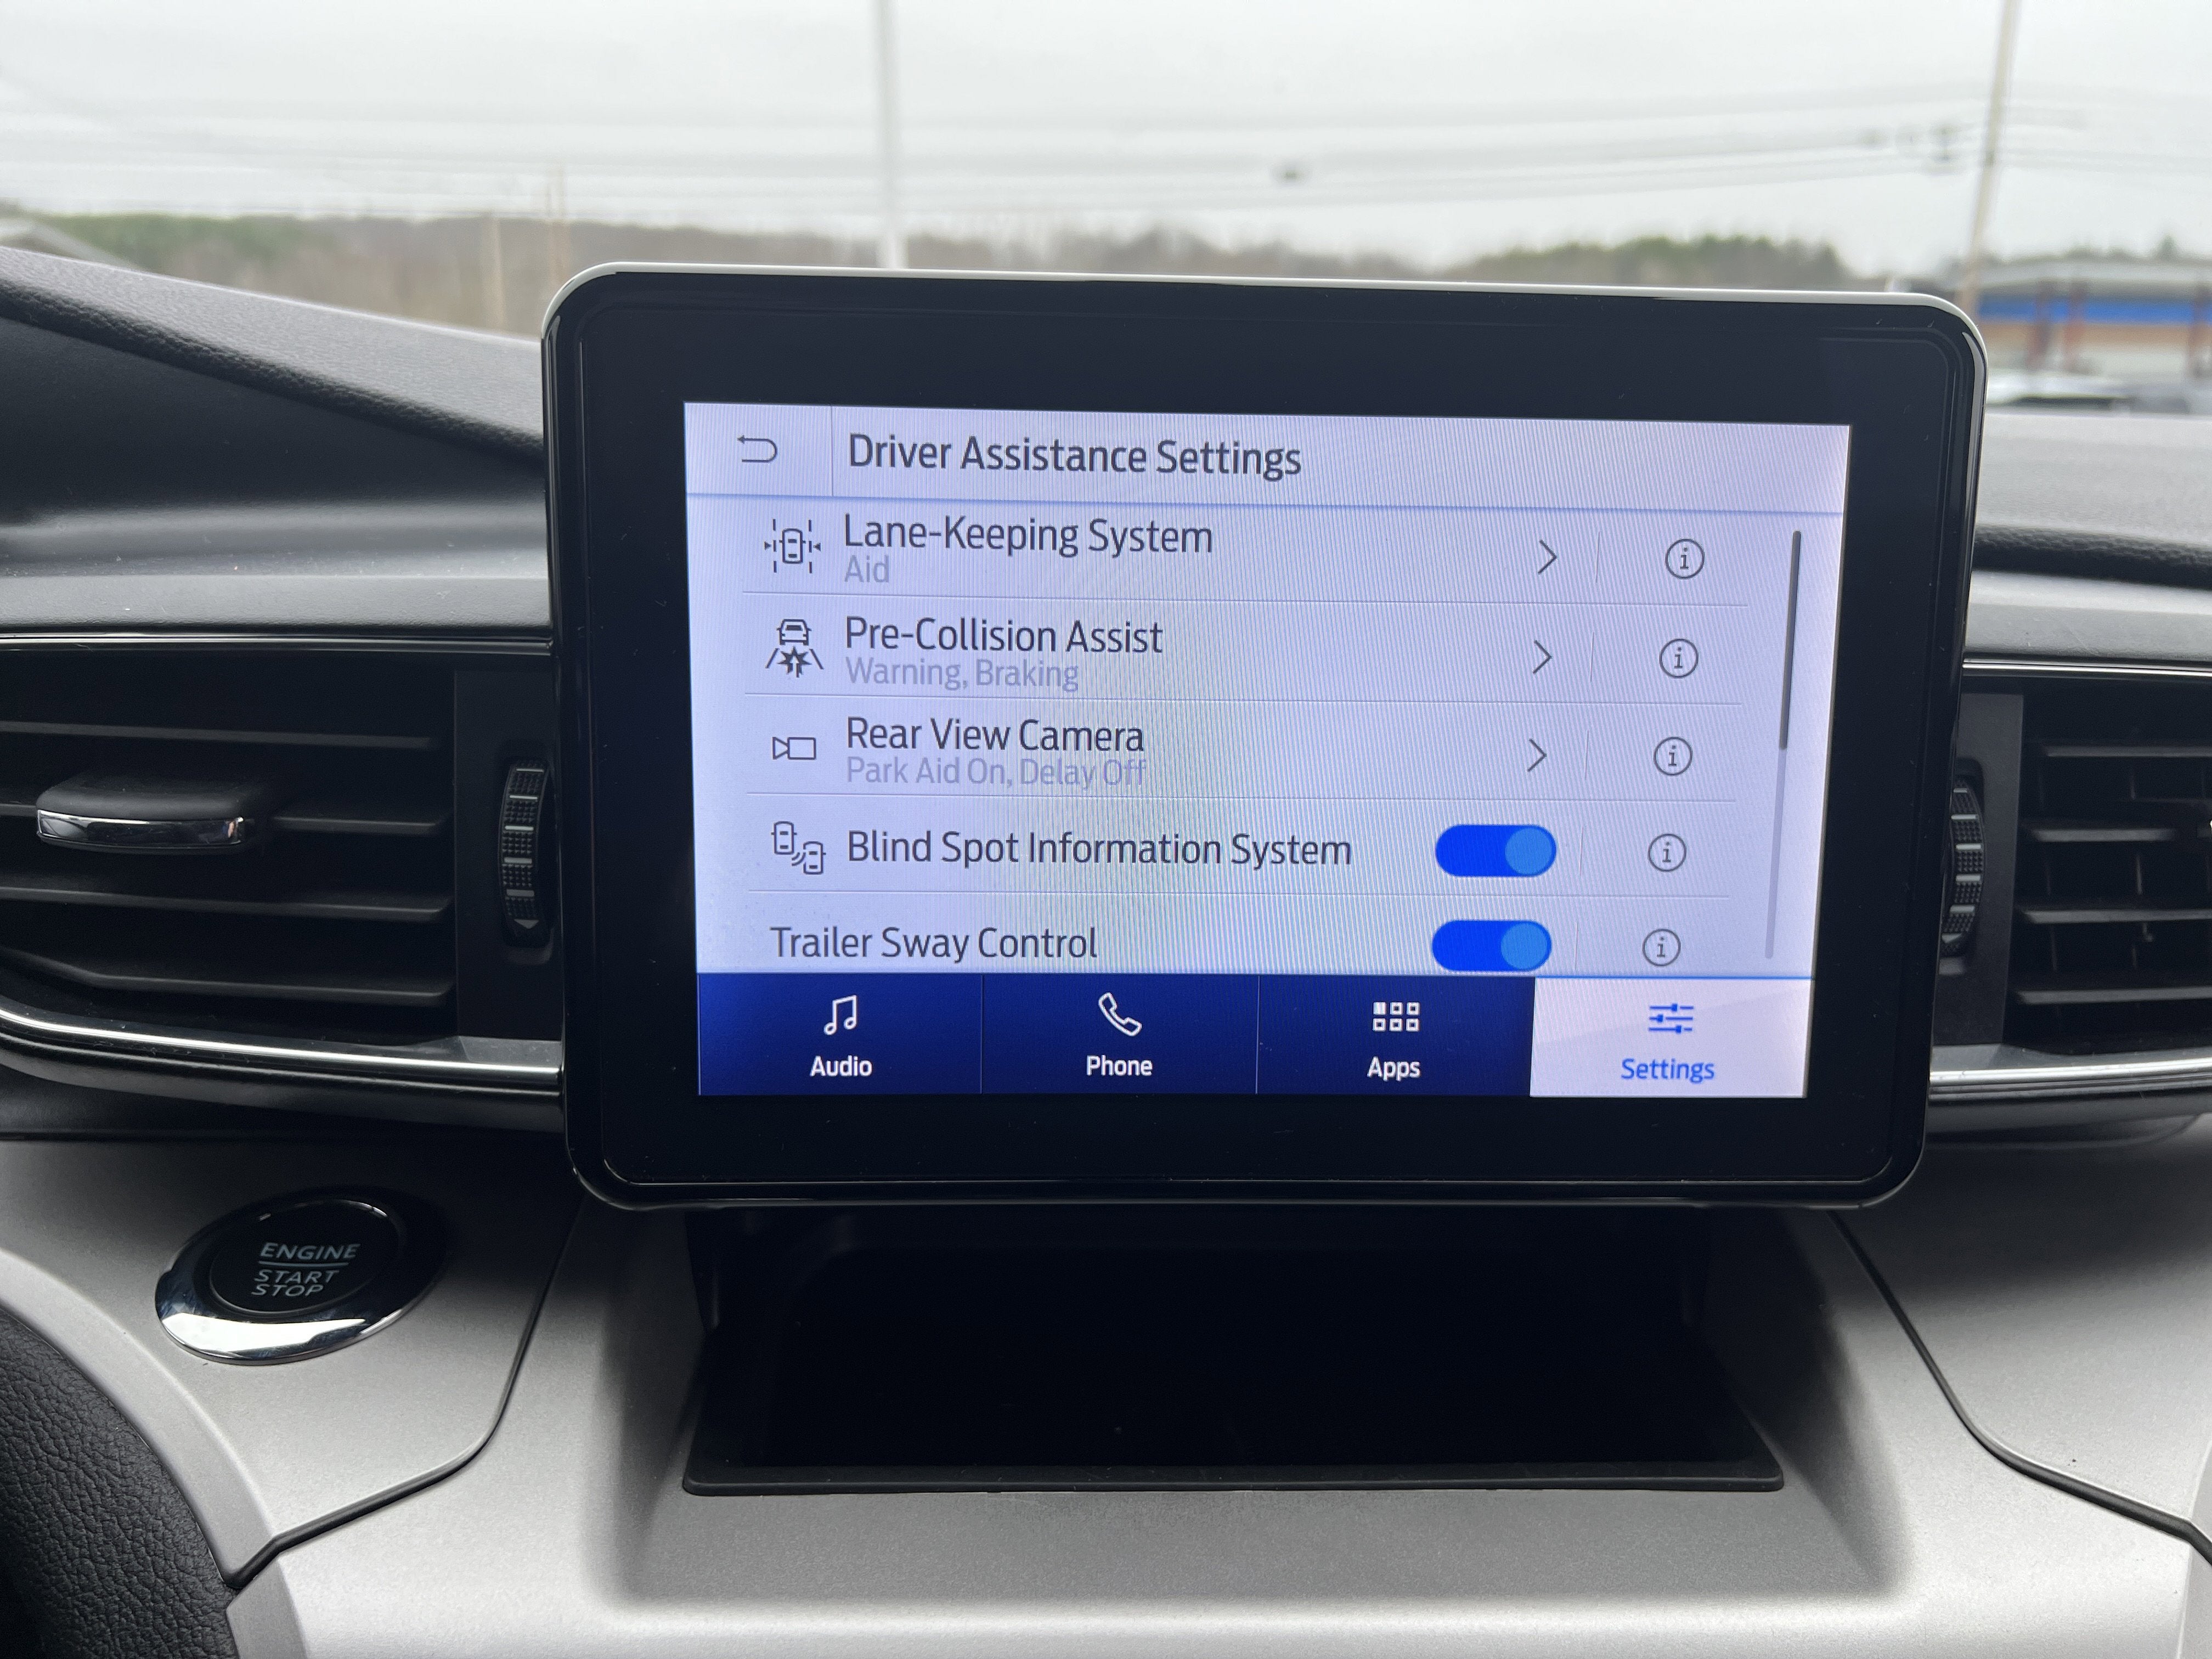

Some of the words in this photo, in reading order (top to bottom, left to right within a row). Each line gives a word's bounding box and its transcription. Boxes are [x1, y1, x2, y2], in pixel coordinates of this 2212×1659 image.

[849, 433, 952, 470] Driver
[961, 436, 1148, 473] Assistance
[1156, 439, 1302, 482] Settings
[844, 514, 1079, 557] Lane-Keeping
[1088, 518, 1213, 557] System
[844, 555, 890, 584] Aid
[846, 616, 1057, 652] Pre-Collision
[1066, 620, 1164, 654] Assist
[846, 658, 969, 691] Warning,
[976, 660, 1079, 692] Braking
[847, 716, 922, 749] Rear
[930, 718, 1011, 751] View
[1019, 719, 1145, 753] Camera
[847, 757, 909, 783] Park
[916, 758, 960, 785] Aid
[967, 759, 1013, 787] On,
[1020, 759, 1096, 791] Delay
[1103, 759, 1148, 786] Off
[848, 831, 931, 864] Blind
[941, 832, 1018, 869] Spot
[1029, 832, 1221, 865] Information
[1231, 834, 1352, 870] System
[770, 927, 872, 958] Trailer
[881, 928, 970, 964] Sway
[978, 927, 1098, 958] Control
[810, 1056, 873, 1077] Audio
[1086, 1056, 1153, 1077] Phone
[1367, 1057, 1421, 1080] Apps
[1621, 1058, 1715, 1083] Settings
[260, 1243, 360, 1260] ENGINE
[251, 1284, 324, 1297] STOP
[255, 1269, 340, 1283] START
